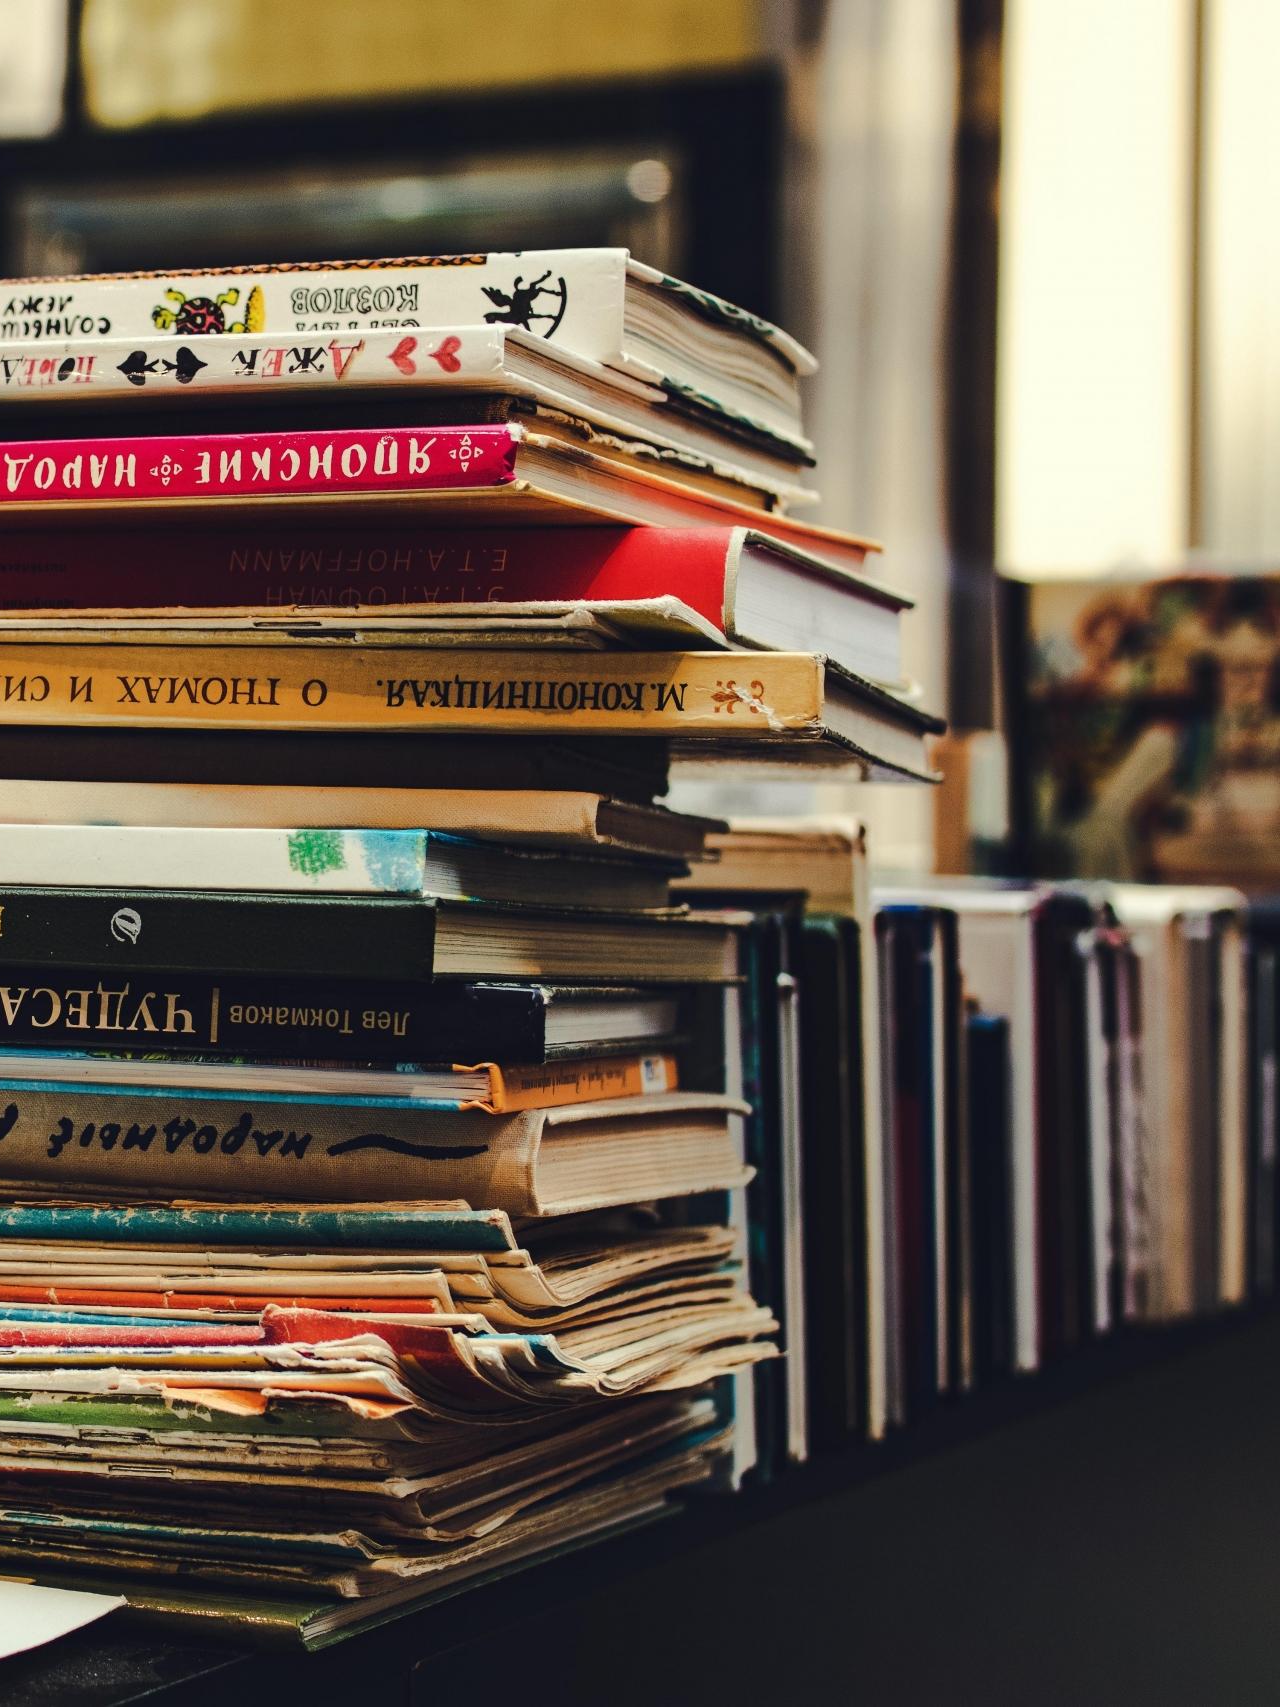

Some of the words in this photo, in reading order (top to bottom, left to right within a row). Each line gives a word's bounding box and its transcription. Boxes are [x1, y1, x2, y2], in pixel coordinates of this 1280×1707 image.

[4, 296, 73, 316] ЛЕЖУ
[291, 284, 418, 314] КОЗЛОВ
[232, 339, 366, 380] ДЖЕК
[192, 438, 438, 485] ЯПОНСКИЕ
[69, 676, 93, 707] И
[116, 675, 280, 708] ГНОМАХ
[303, 679, 329, 709] О
[230, 1005, 353, 1033] Токмаков
[362, 1011, 410, 1035] Лев
[46, 1113, 312, 1158] народные
